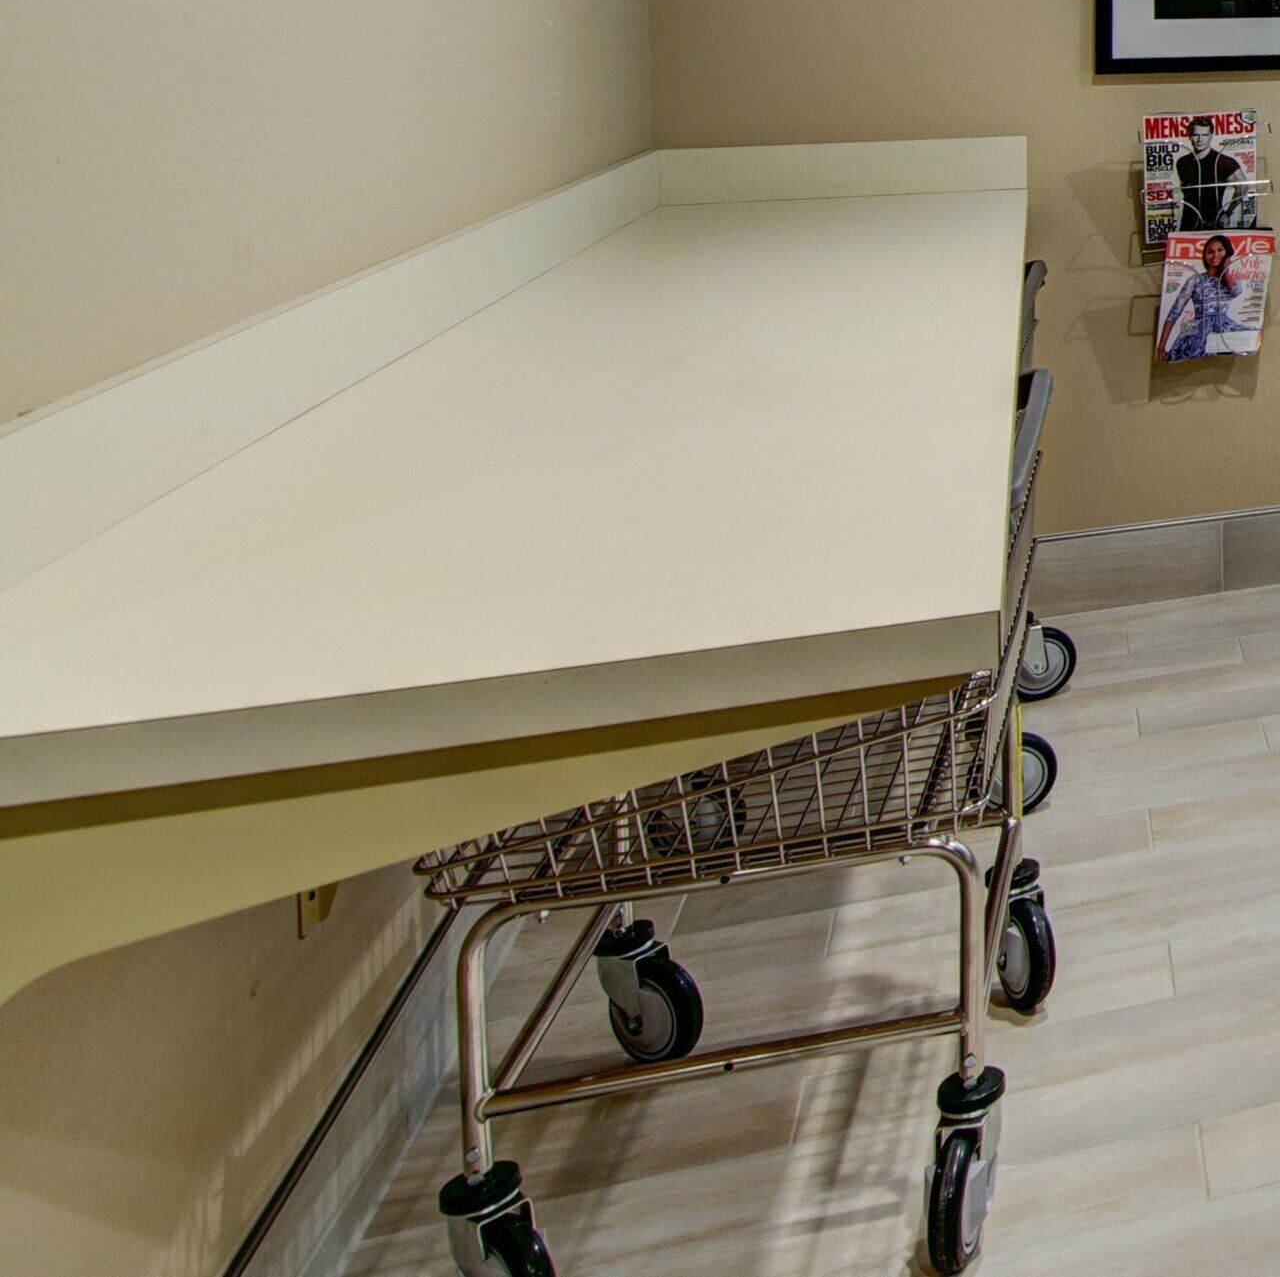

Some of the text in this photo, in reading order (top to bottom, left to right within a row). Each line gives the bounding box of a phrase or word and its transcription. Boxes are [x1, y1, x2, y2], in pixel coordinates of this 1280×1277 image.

[1146, 143, 1180, 155] BUILD
[1147, 153, 1174, 167] BIG
[1146, 189, 1174, 201] SEX
